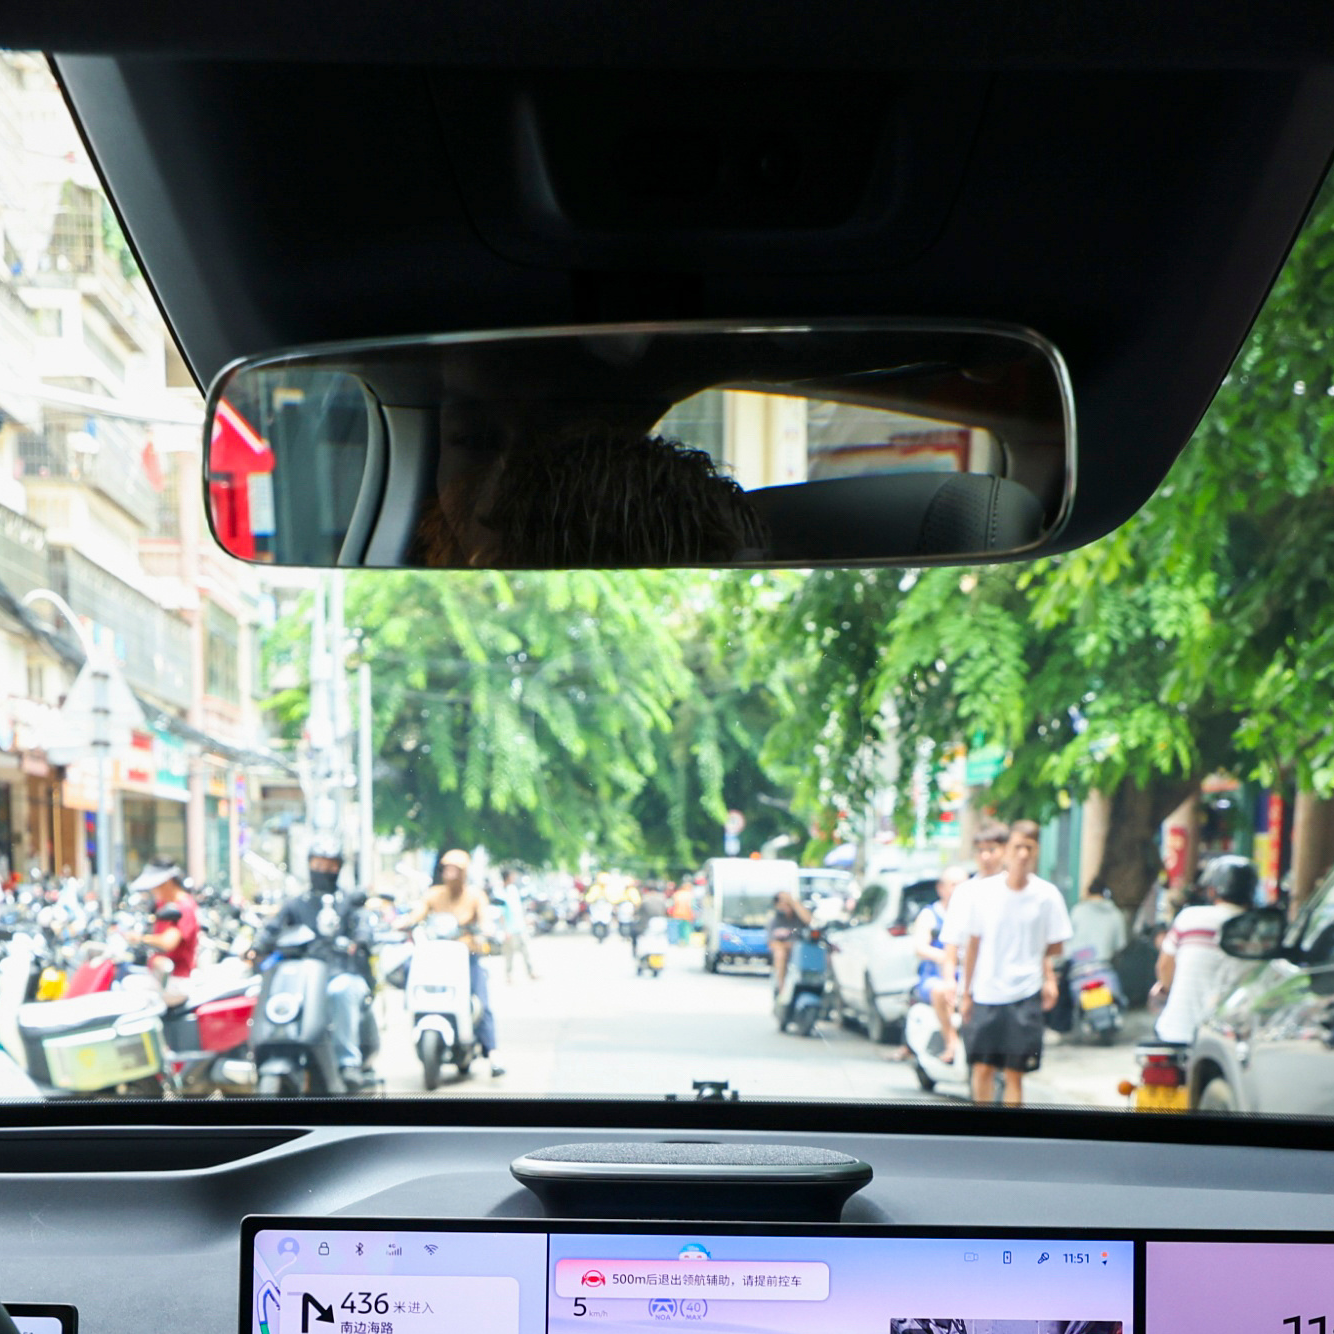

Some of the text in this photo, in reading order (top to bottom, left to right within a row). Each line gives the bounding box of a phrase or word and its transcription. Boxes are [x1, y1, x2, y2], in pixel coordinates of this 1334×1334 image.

[1062, 1253, 1090, 1264] 11:51
[612, 1273, 802, 1288] 500m后退出领航辅助，请提前控车
[340, 1291, 435, 1315] 436 米进入
[572, 1297, 609, 1318] 5 km/h
[686, 1302, 702, 1313] 40
[340, 1321, 394, 1334] 南边海路
